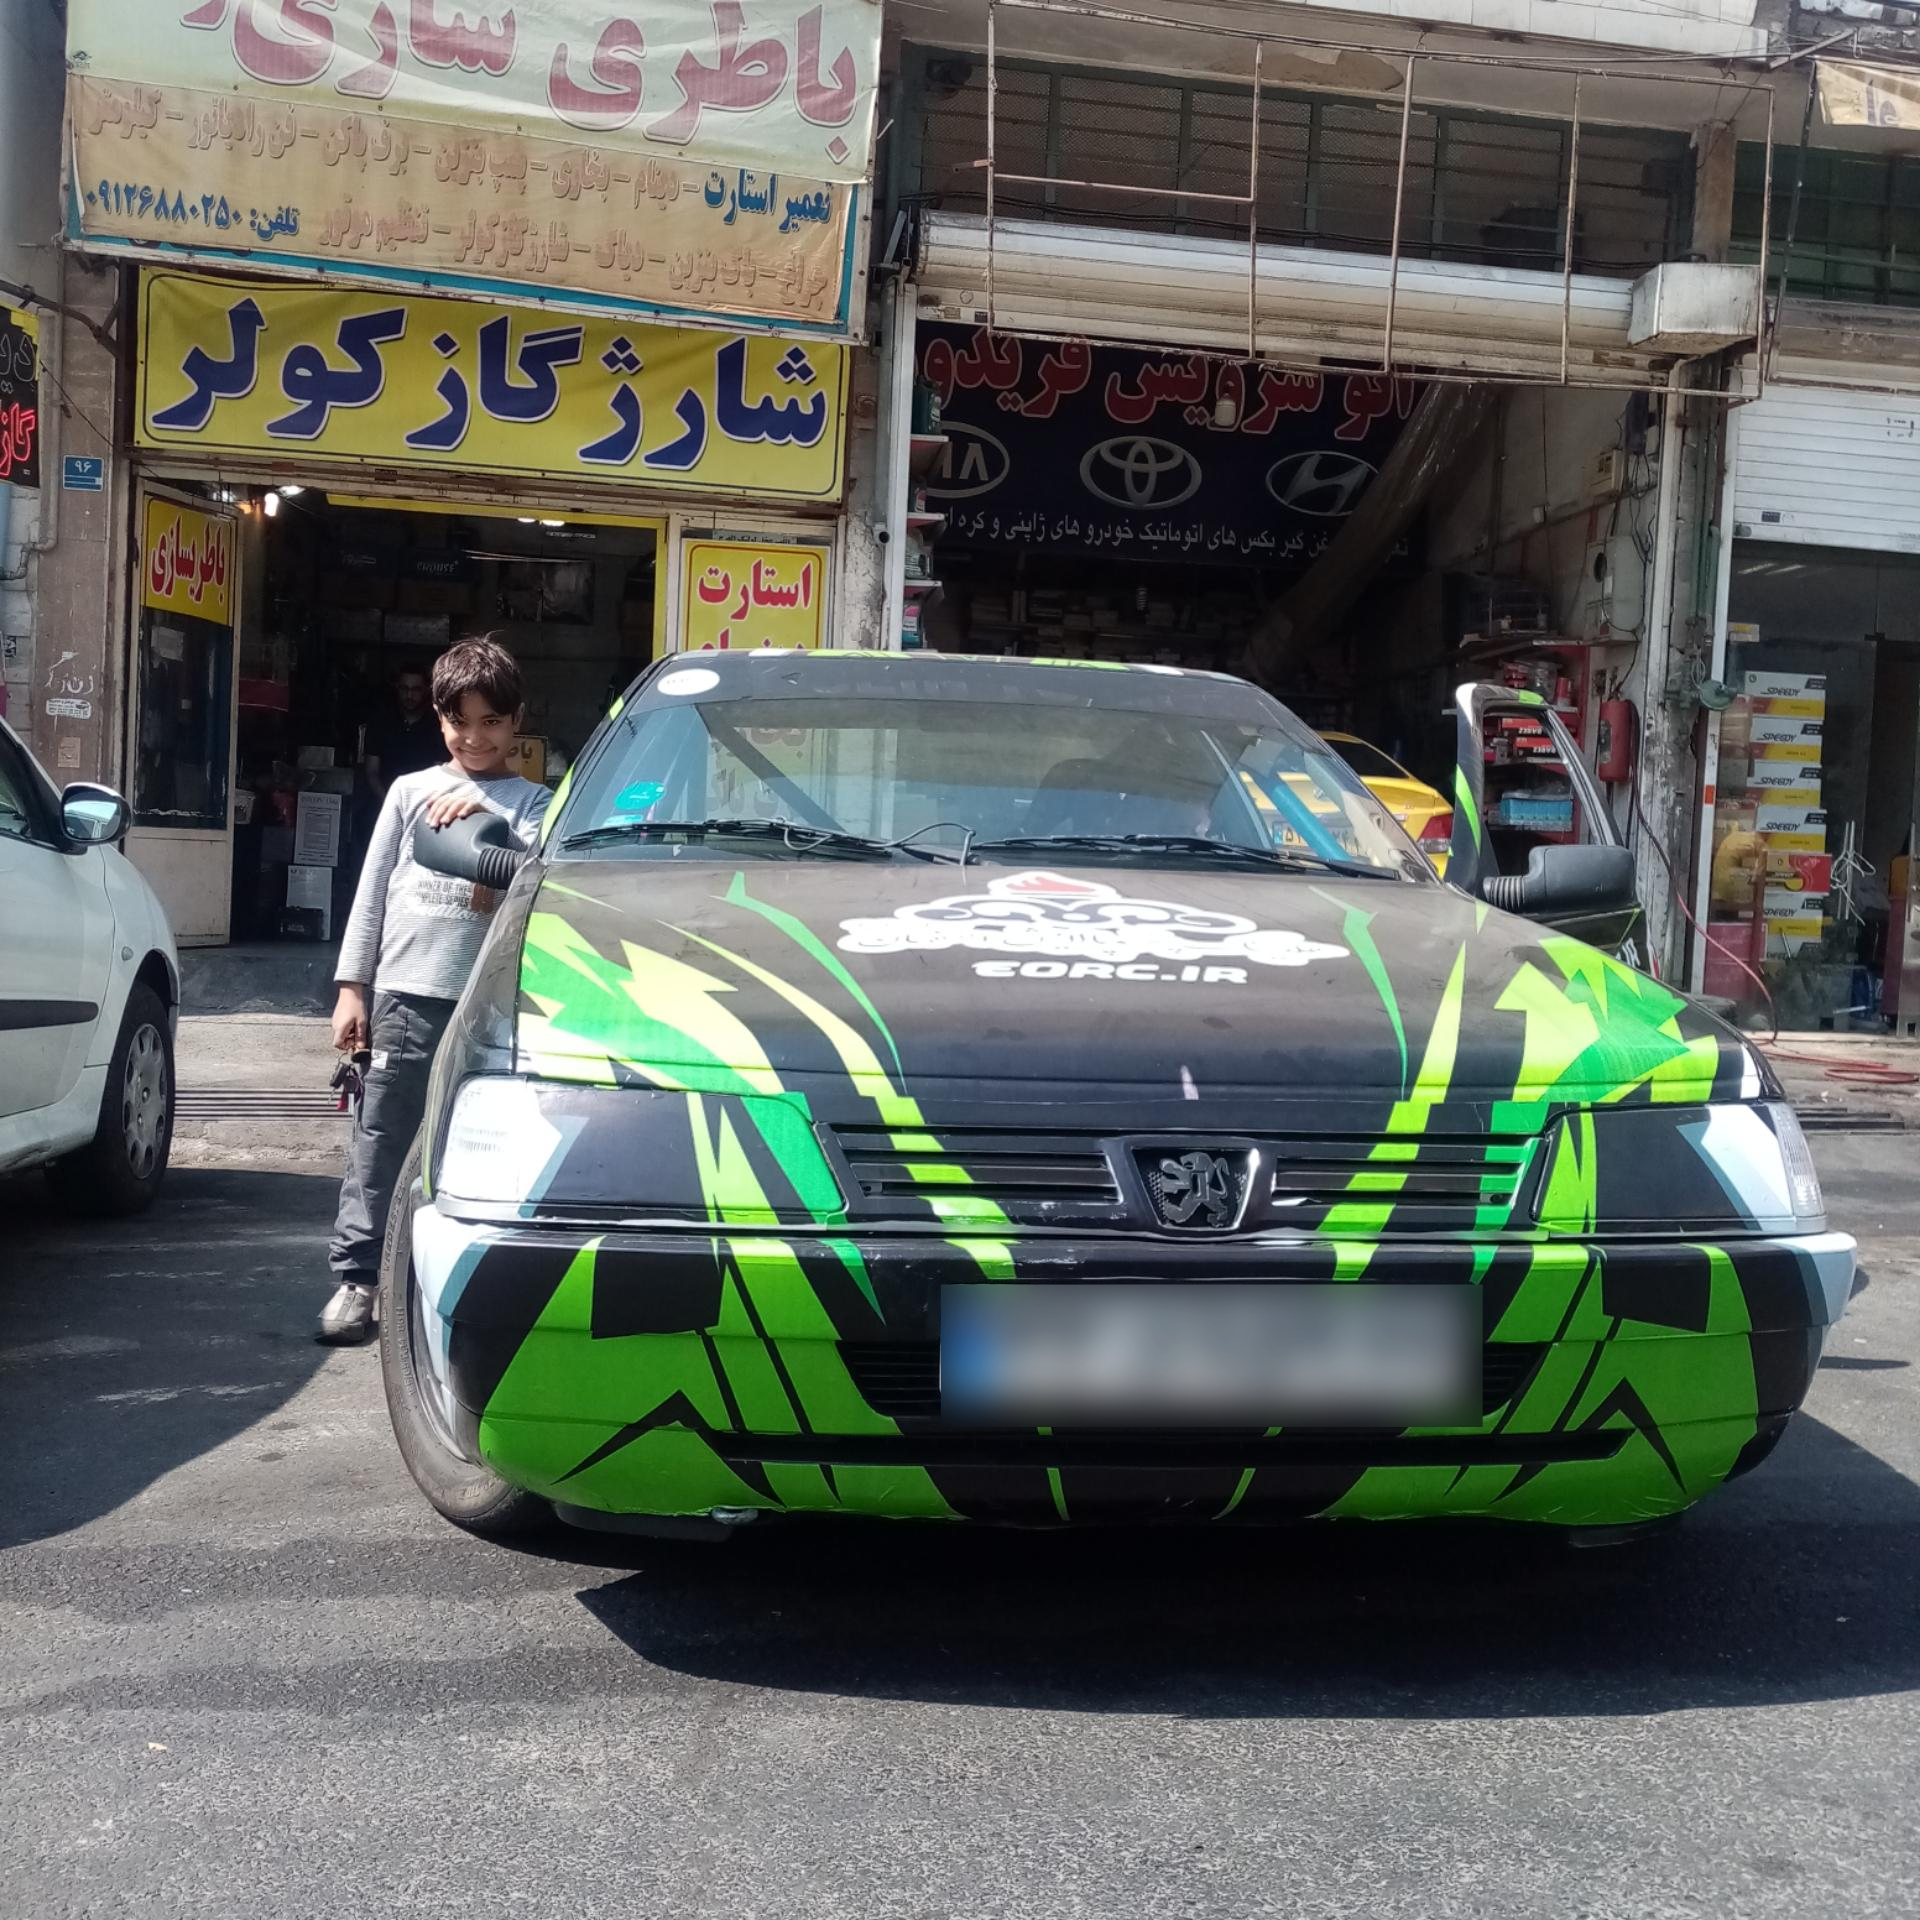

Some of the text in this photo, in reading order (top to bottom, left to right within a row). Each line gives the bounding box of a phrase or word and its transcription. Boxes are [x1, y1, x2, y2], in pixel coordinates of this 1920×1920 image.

[704, 168, 778, 225] استارت
[779, 182, 834, 233] تعمیر
[148, 296, 409, 441] کولر
[405, 314, 586, 452] گاز
[576, 334, 830, 472] شارژ
[74, 459, 93, 474] ۹۶
[957, 511, 985, 538] کره
[989, 516, 1000, 539] و
[1005, 511, 1047, 543] ژاپنی
[1050, 514, 1081, 541] های
[1138, 520, 1204, 551] اتوماتیک
[1206, 523, 1237, 549] های
[1240, 529, 1276, 557] بکس
[697, 557, 813, 622] استارت
[1766, 686, 1801, 697] SPEEDY
[1762, 732, 1797, 743] SPEEDY
[1765, 821, 1801, 832] SPEEDY
